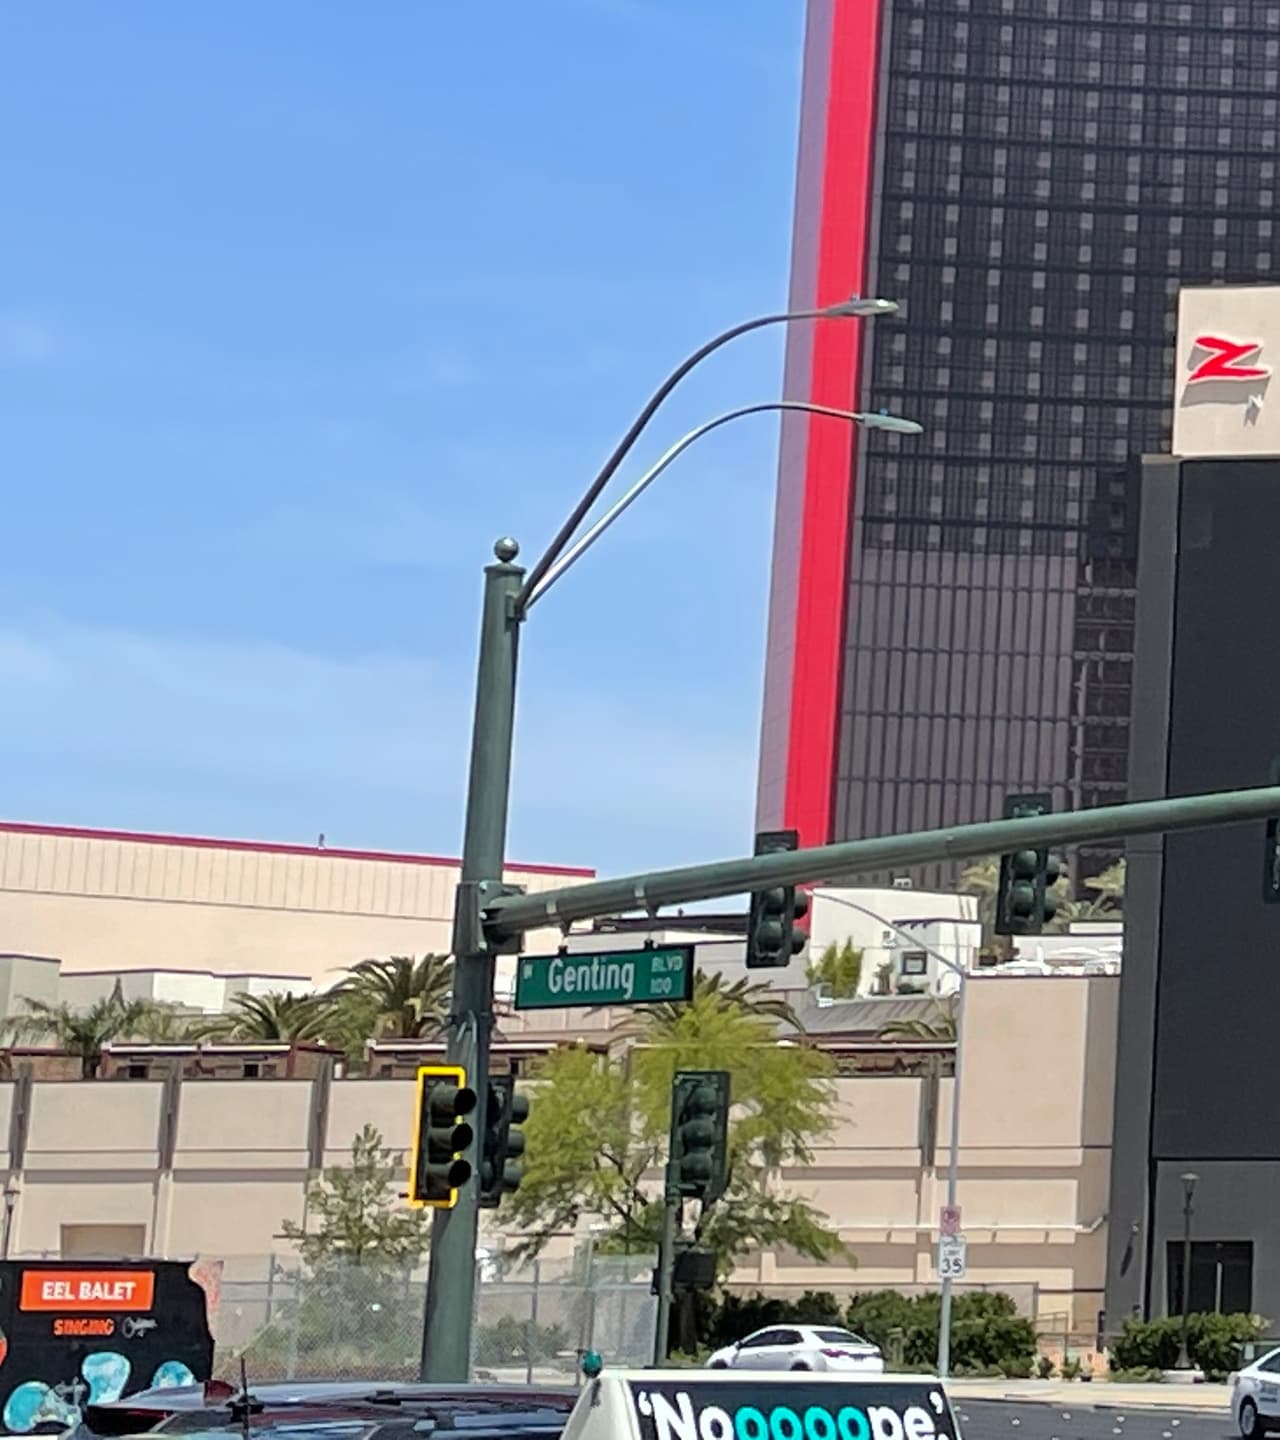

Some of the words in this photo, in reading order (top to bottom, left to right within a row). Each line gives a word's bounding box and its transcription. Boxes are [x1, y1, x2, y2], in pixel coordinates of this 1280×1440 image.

[548, 958, 634, 1000] Genting
[652, 955, 683, 972] BLVD
[942, 1257, 962, 1274] 35
[42, 1281, 75, 1300] EEL
